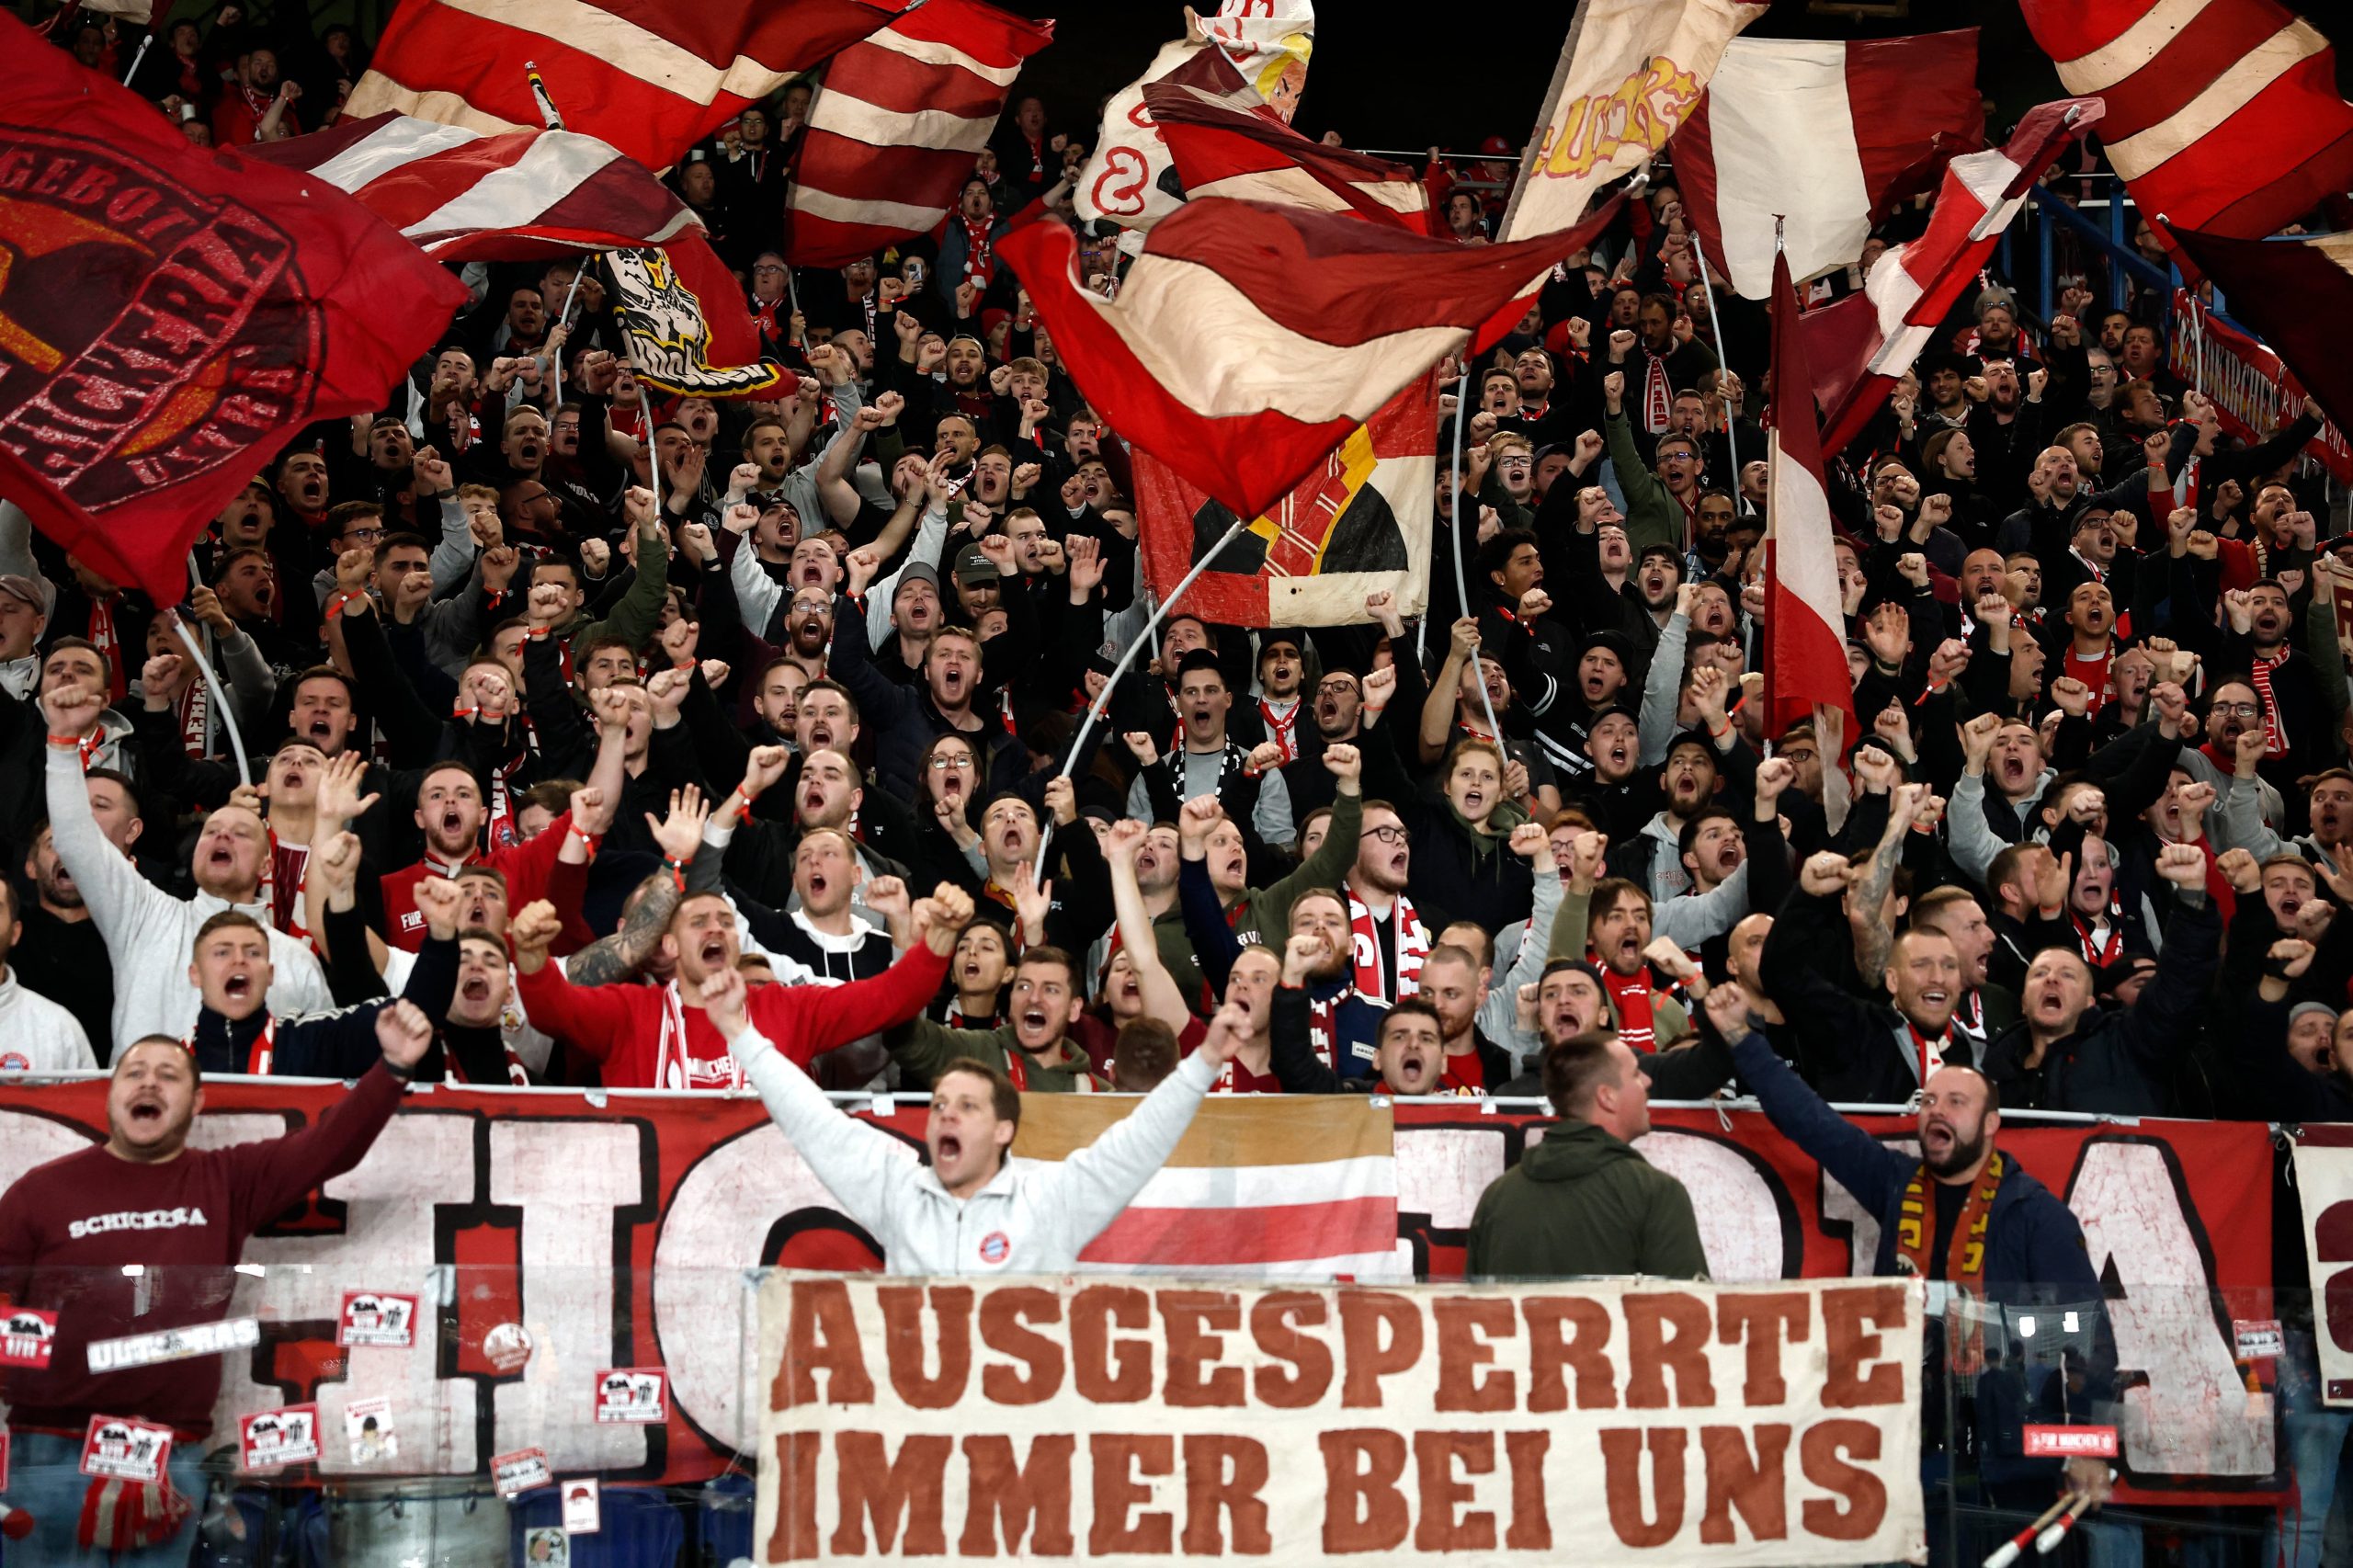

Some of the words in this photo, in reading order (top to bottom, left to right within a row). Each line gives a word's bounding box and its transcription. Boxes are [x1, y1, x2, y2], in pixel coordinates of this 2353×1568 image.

[0, 147, 199, 241] GEBOT
[0, 222, 288, 487] HICKERIA
[769, 1280, 1906, 1412] AUSGESPERRTE
[767, 1430, 1272, 1563] IMMER
[1320, 1428, 1551, 1552] BEI
[1600, 1419, 1887, 1549] UNS
